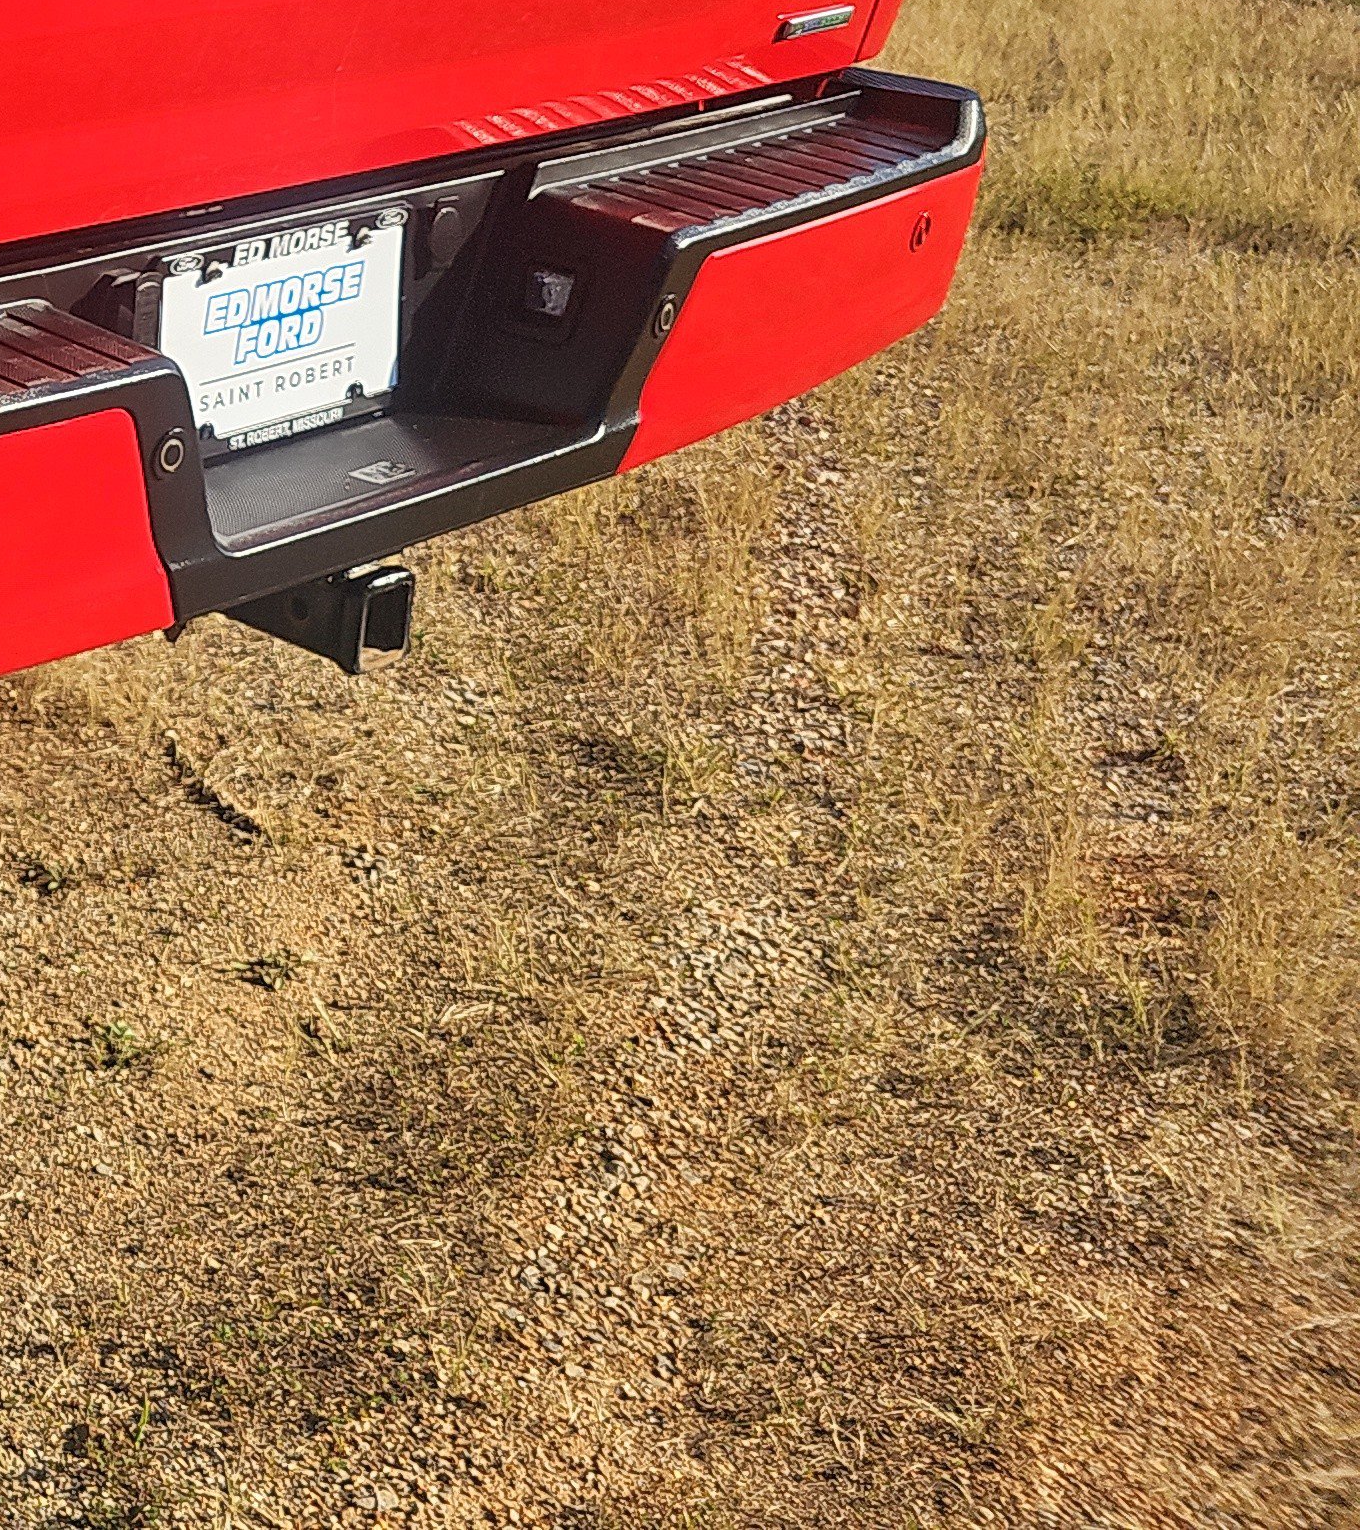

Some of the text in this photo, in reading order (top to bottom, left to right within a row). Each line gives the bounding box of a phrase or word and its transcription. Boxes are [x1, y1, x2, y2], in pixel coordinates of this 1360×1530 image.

[234, 240, 267, 267] ED
[269, 220, 350, 257] MORSE
[204, 261, 364, 335] ED MORSE
[234, 308, 323, 365] FORD
[199, 356, 354, 412] SAINT ROBERT
